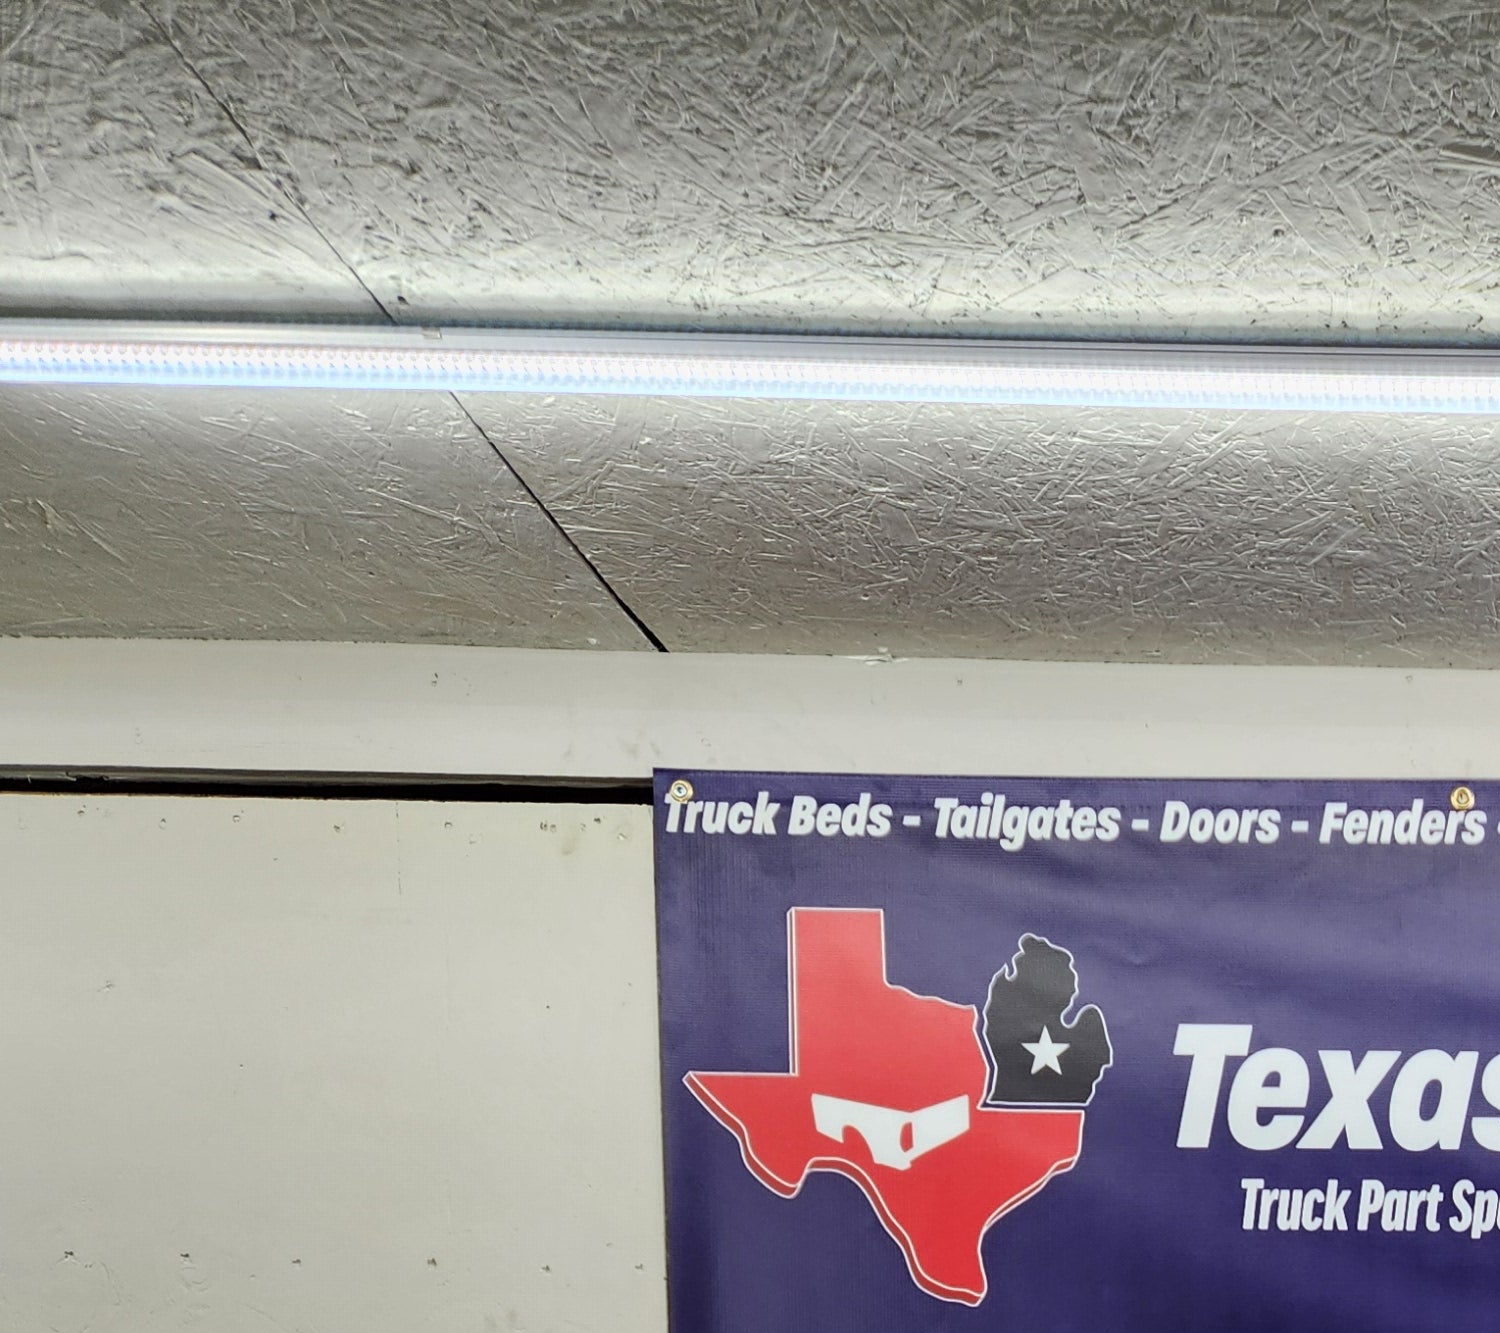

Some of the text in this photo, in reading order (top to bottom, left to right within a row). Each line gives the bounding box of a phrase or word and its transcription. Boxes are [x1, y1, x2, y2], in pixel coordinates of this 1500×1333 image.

[664, 790, 781, 834] Truck
[787, 792, 893, 838] Beds
[934, 792, 1122, 852] Tailgates
[1159, 800, 1282, 844] Doors
[1318, 798, 1488, 846] Fenders
[1241, 1178, 1352, 1232] Truck
[1357, 1179, 1444, 1232] Part
